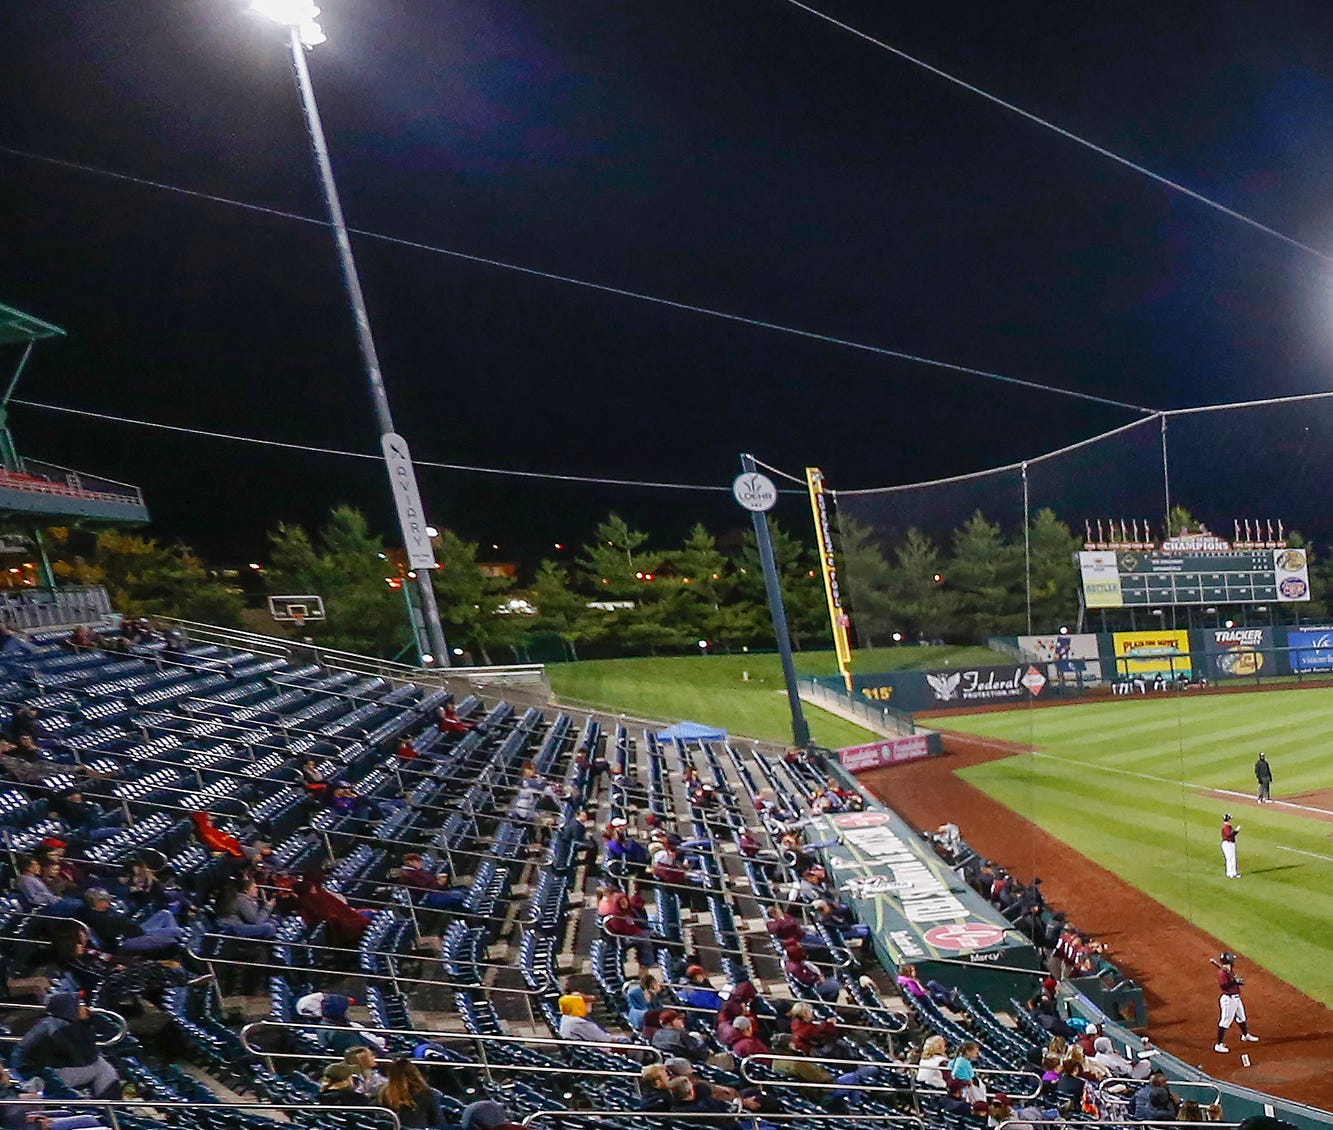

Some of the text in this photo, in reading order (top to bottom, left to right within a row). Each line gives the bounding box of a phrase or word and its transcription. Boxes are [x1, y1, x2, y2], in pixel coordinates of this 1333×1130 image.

[1162, 541, 1229, 550] CHAMPIONS
[1214, 630, 1263, 642] TRACKER
[963, 668, 1021, 692] Federal
